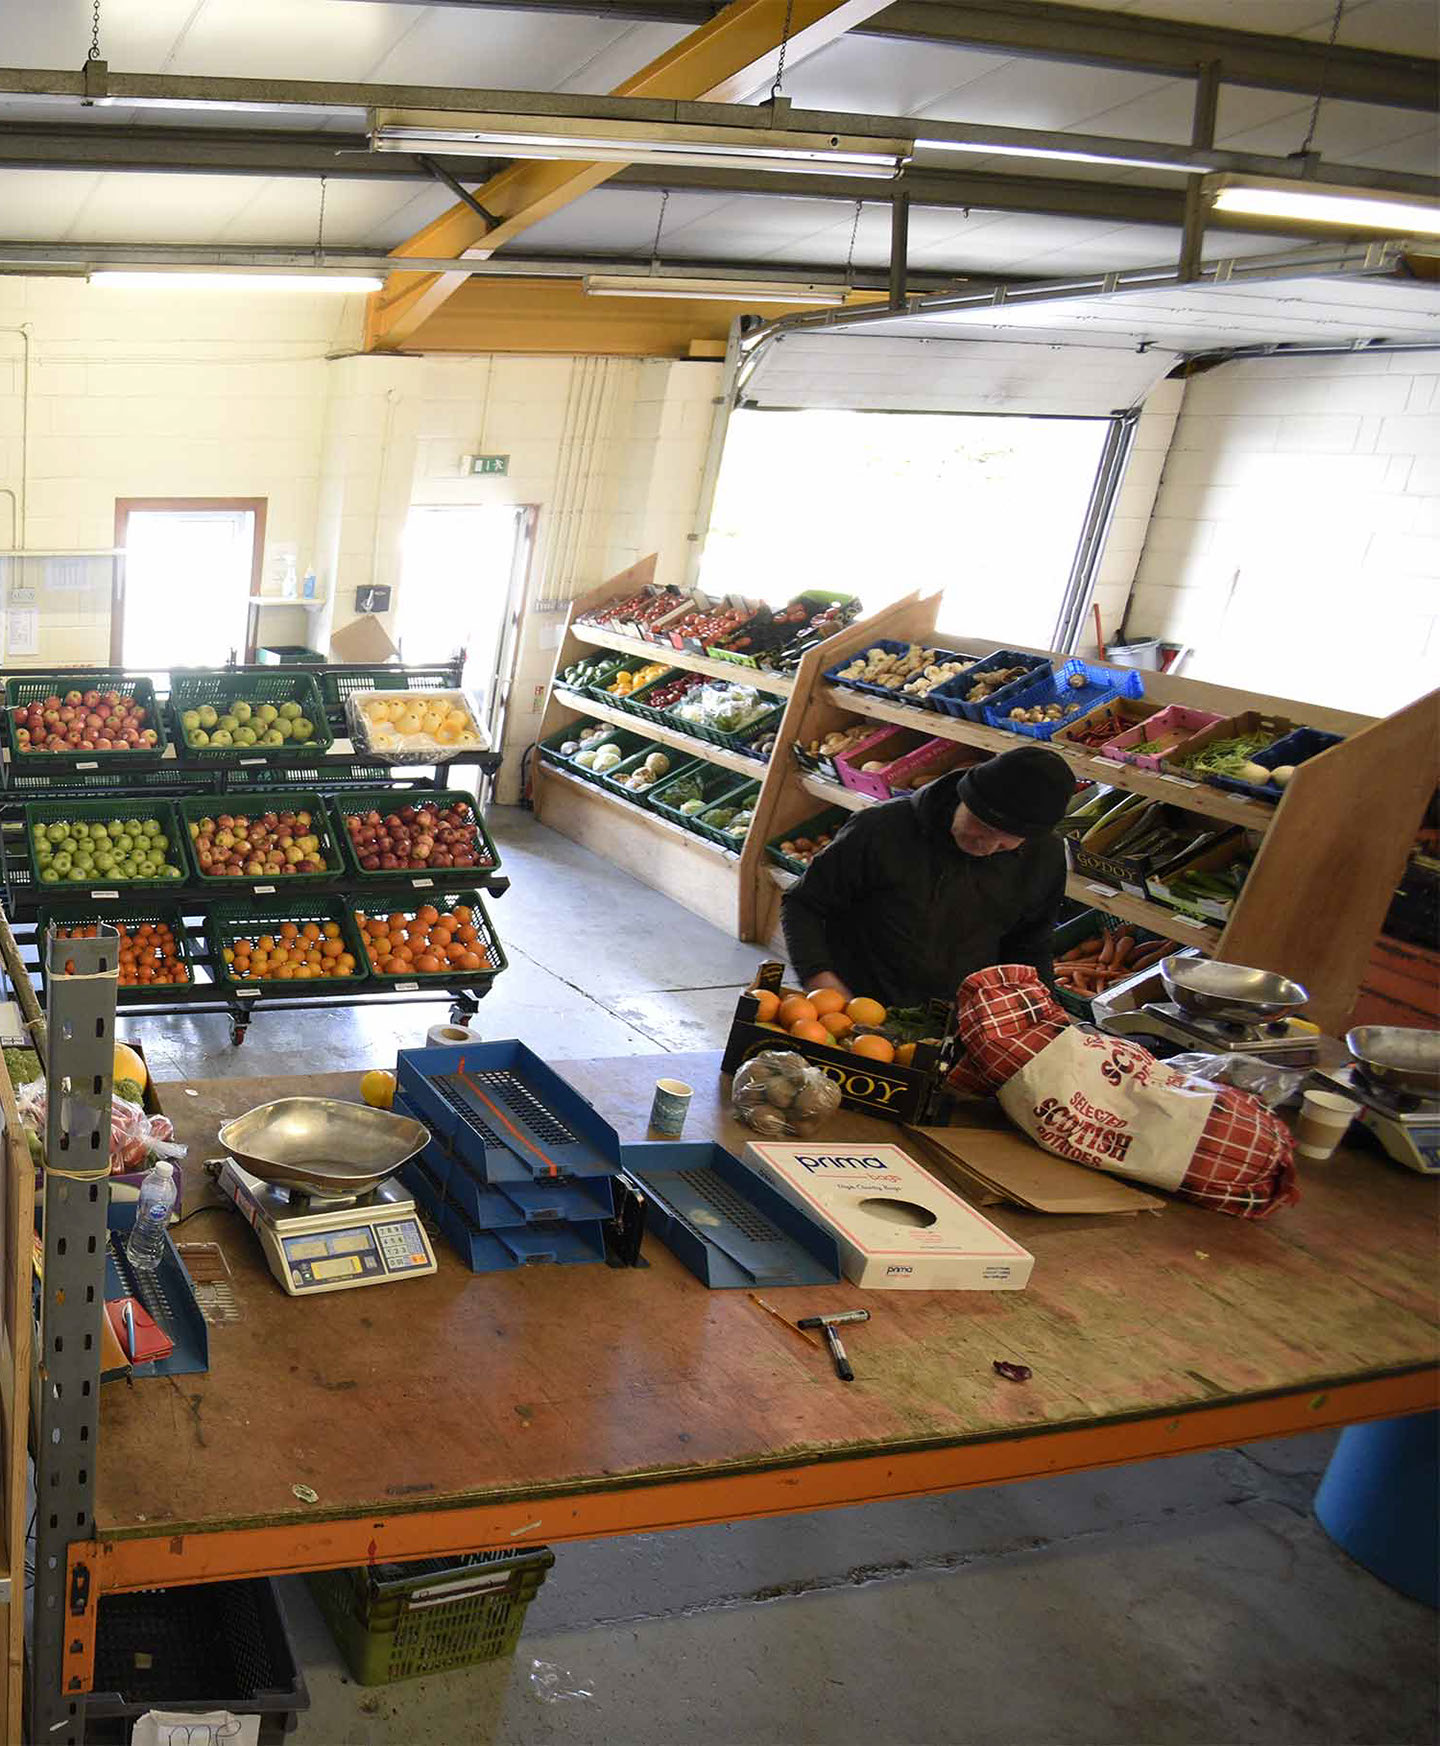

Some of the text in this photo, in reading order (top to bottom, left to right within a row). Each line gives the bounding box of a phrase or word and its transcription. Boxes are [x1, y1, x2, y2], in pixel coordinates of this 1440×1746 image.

[818, 1063, 908, 1105] DOY
[1070, 1091, 1128, 1129] SELECTED
[1033, 1097, 1134, 1163] SCOTTISH
[794, 1154, 888, 1174] prima
[886, 1265, 914, 1275] prima
